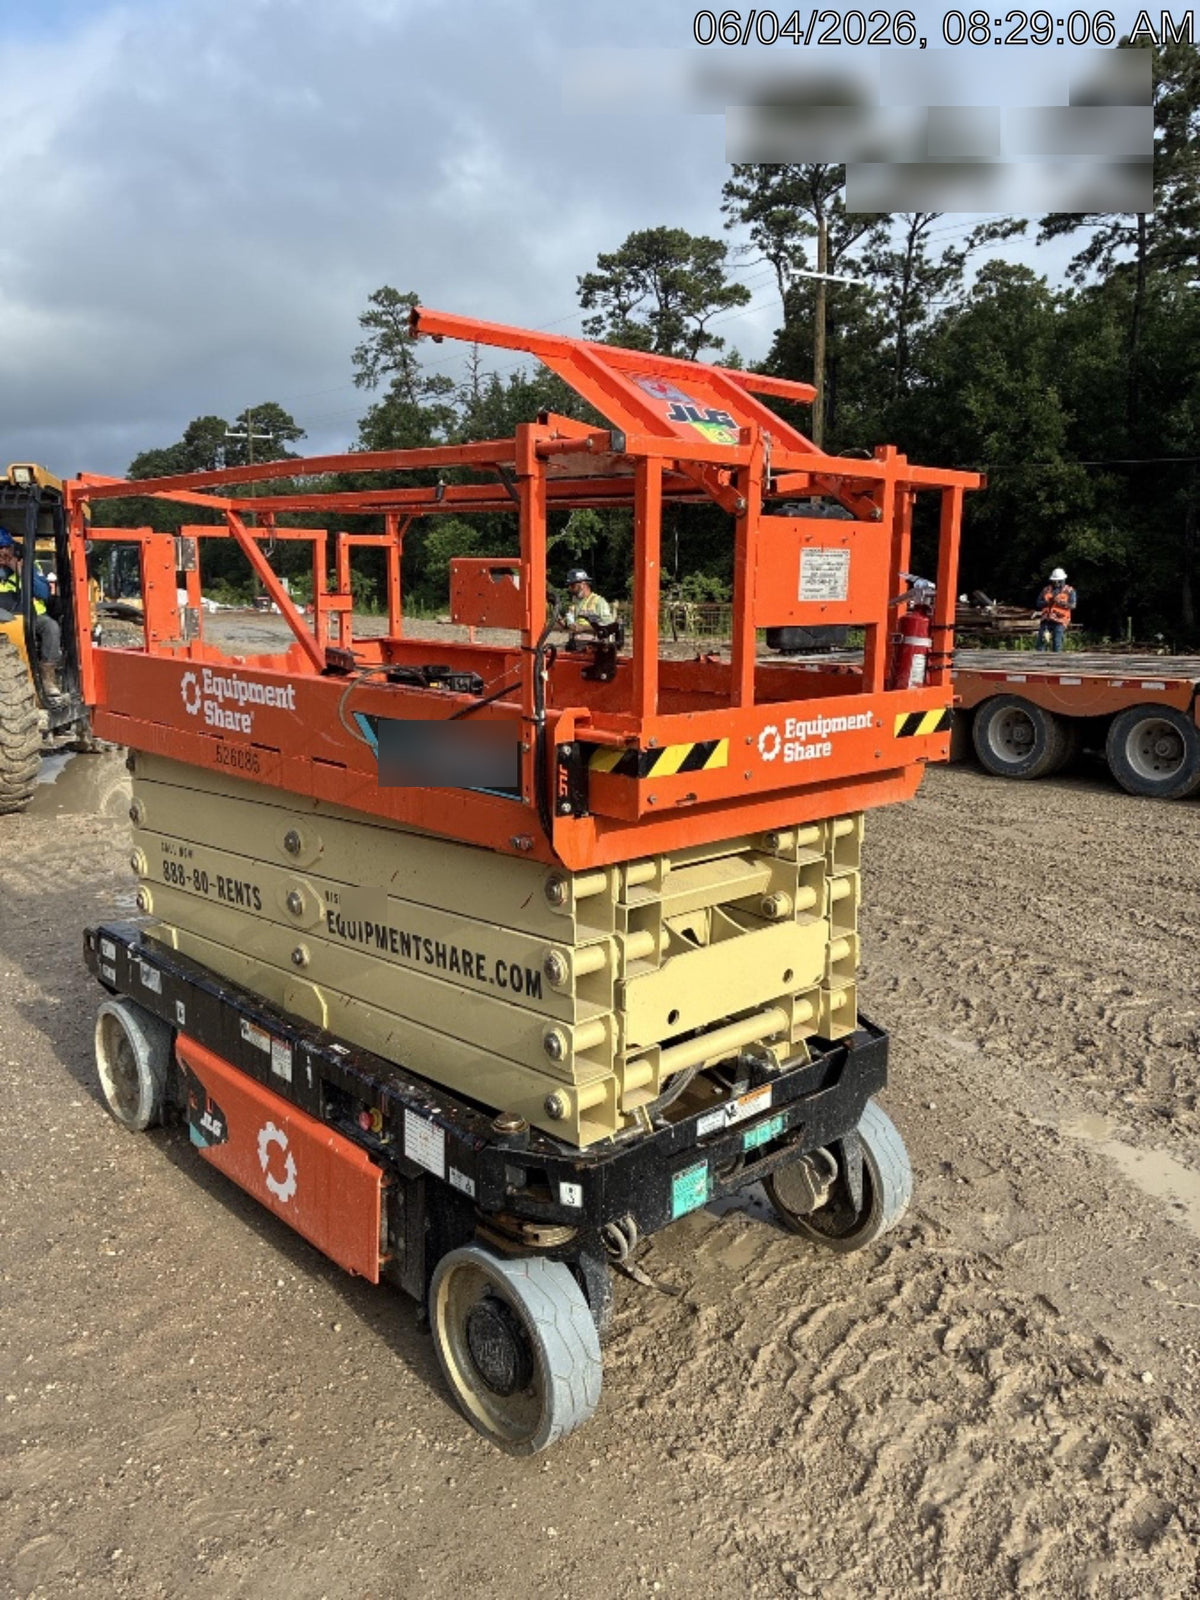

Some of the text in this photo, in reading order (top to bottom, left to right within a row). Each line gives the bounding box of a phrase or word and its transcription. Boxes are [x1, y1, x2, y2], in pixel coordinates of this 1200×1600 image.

[665, 401, 738, 430] JLG
[202, 667, 296, 710] Equipment
[203, 699, 252, 734] Share
[784, 710, 874, 742] Equipment
[783, 741, 832, 763] Share
[559, 763, 569, 797] JLG
[162, 859, 263, 911] 888-80-RENTS
[326, 909, 543, 1000] EQUIPMENTSHARE.COM
[200, 1111, 223, 1137] JLG
